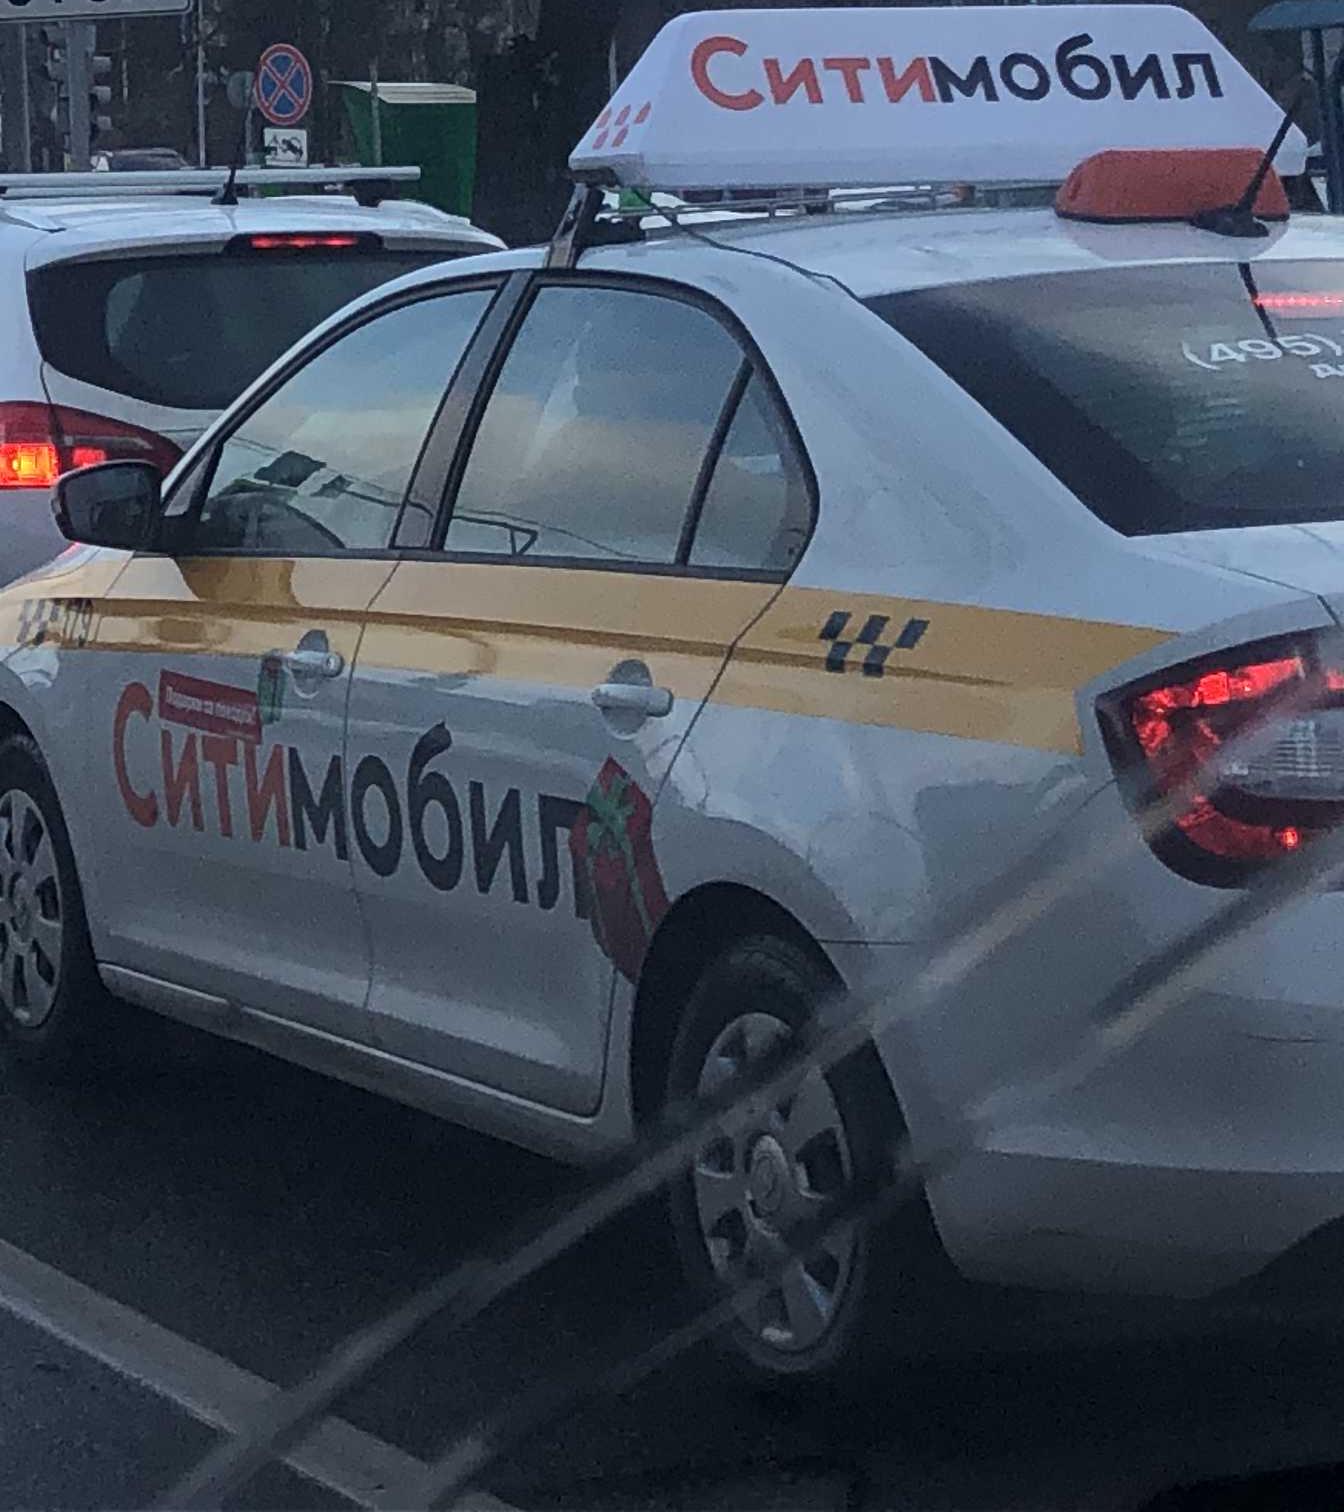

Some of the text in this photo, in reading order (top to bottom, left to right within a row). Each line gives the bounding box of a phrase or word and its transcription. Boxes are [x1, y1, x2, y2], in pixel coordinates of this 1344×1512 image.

[690, 32, 1224, 112] Ситимобил
[1181, 333, 1343, 370] (495)
[113, 681, 592, 920] Ситимобил
